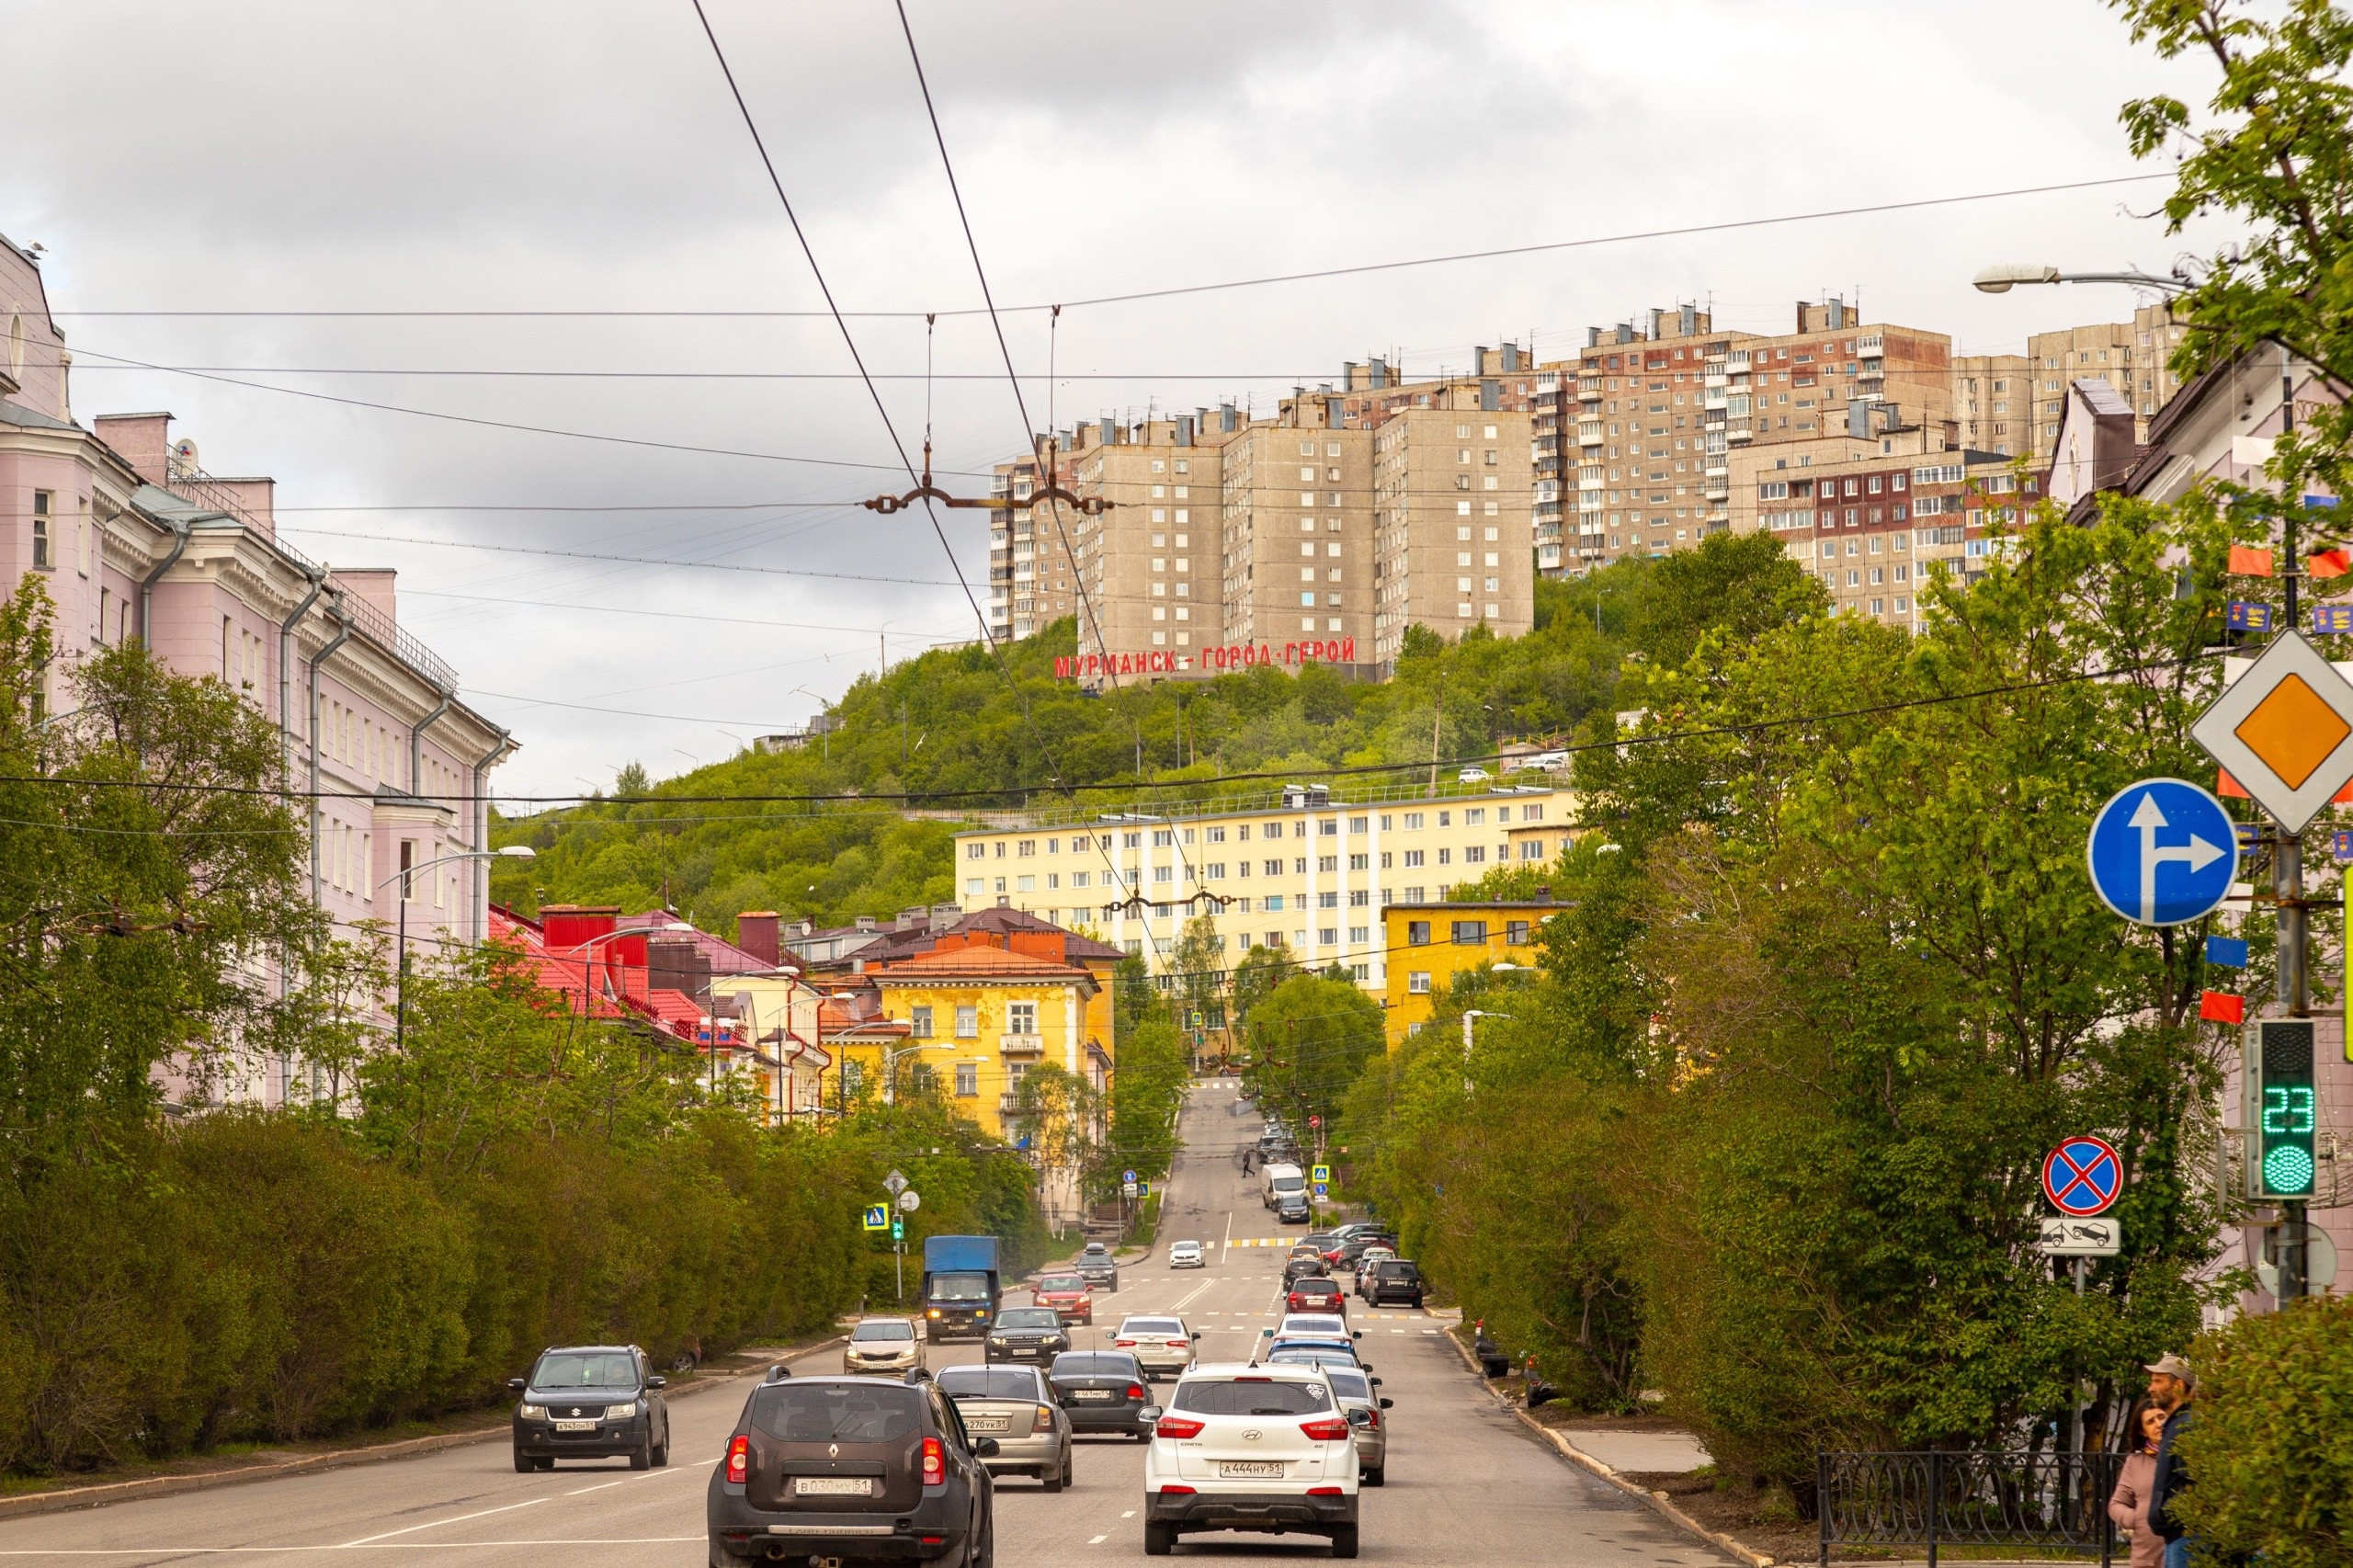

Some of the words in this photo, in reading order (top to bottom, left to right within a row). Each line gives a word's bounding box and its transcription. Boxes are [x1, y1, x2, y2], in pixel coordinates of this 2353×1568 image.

[1054, 650, 1177, 678] МУРМАНСК
[2264, 1088, 2313, 1132] 23
[1269, 1463, 1279, 1471] 51
[854, 1480, 868, 1489] 51
